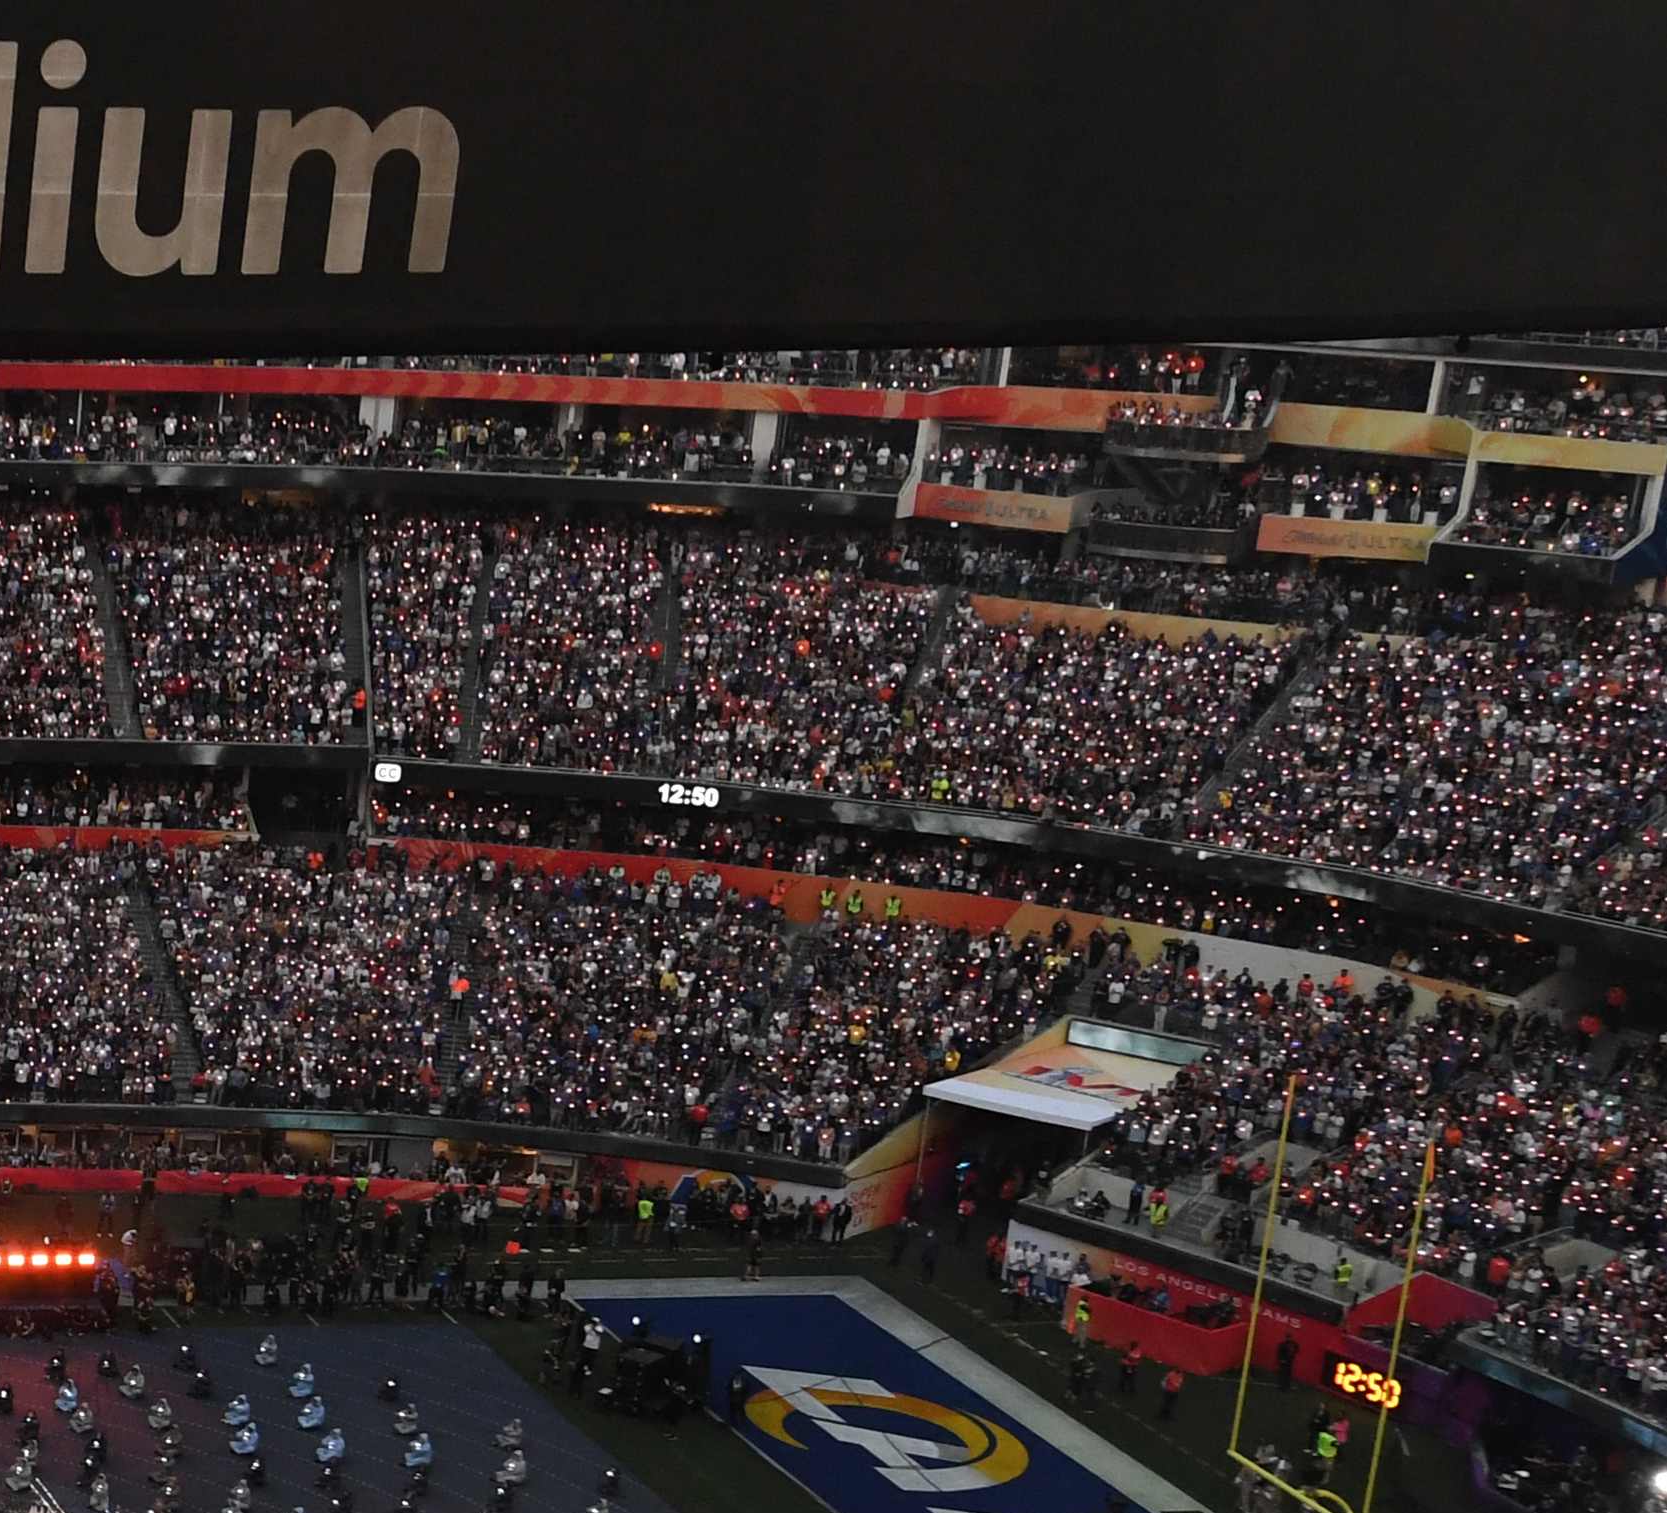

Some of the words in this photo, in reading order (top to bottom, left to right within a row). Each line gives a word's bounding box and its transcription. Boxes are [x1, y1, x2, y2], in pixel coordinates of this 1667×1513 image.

[657, 783, 719, 808] 12:50
[1114, 1260, 1150, 1276] LOS
[1157, 1271, 1243, 1308] ANGELES
[1334, 1362, 1402, 1409] 12:50
